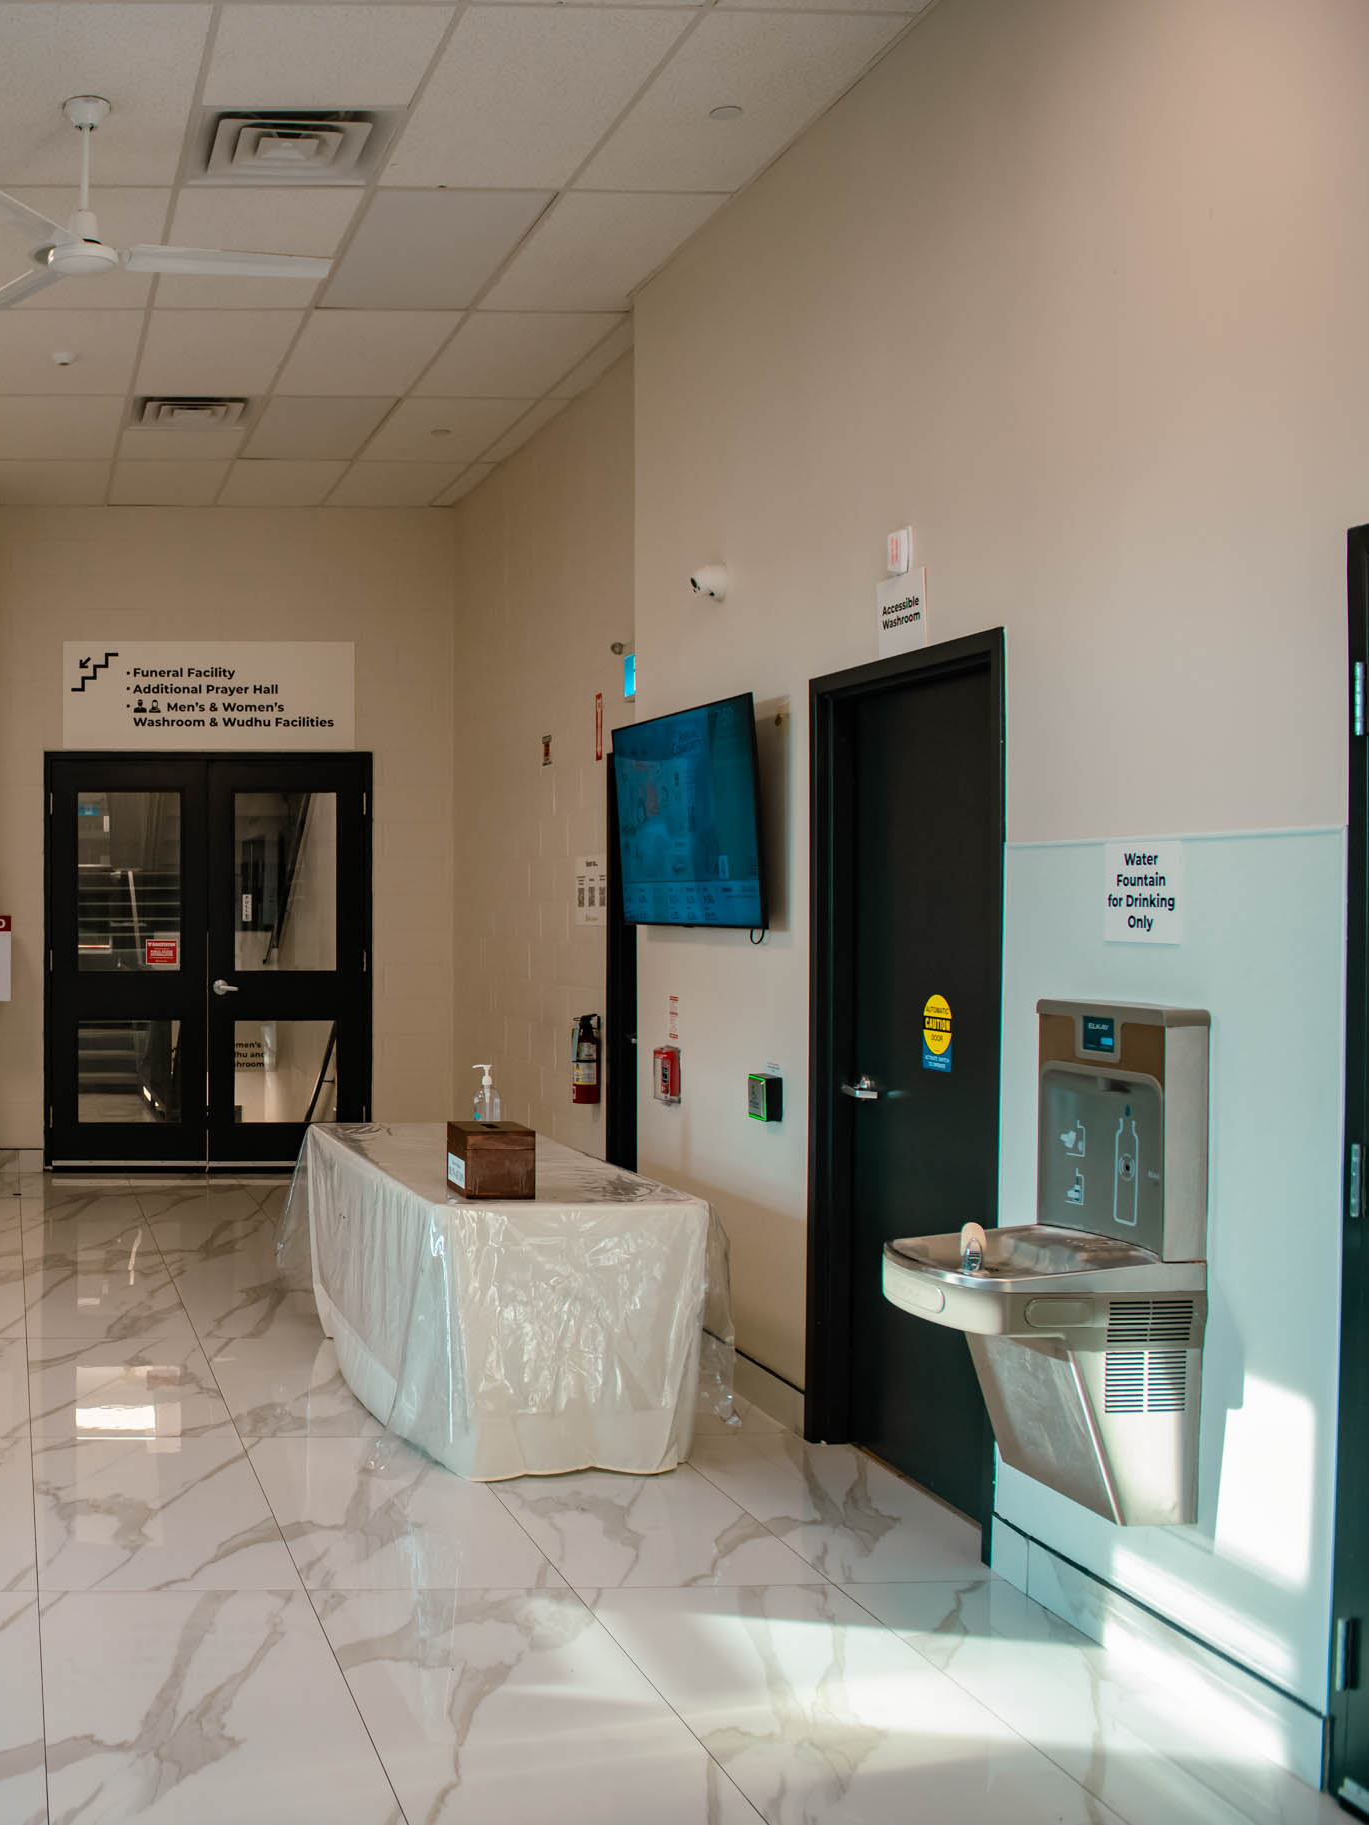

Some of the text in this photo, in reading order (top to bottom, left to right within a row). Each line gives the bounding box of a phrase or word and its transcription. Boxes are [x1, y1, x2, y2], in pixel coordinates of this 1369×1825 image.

[882, 595, 919, 616] Accessible
[882, 611, 921, 630] Washroom
[133, 667, 235, 680] Funeral Facility
[133, 684, 279, 697] Additional Prayer Hall
[209, 703, 218, 713] &
[133, 717, 334, 728] Washroom & Wudhu Facilities
[1124, 852, 1159, 866] Water
[1116, 871, 1166, 887] Fountain
[1107, 892, 1175, 911] for Drinking
[1127, 914, 1154, 932] Only
[926, 1006, 950, 1014] AUTOMATIC
[925, 1017, 951, 1031] CAUTION
[1088, 1022, 1109, 1030] ELKAY
[931, 1034, 943, 1042] DOOR
[236, 1060, 265, 1068] hroom
